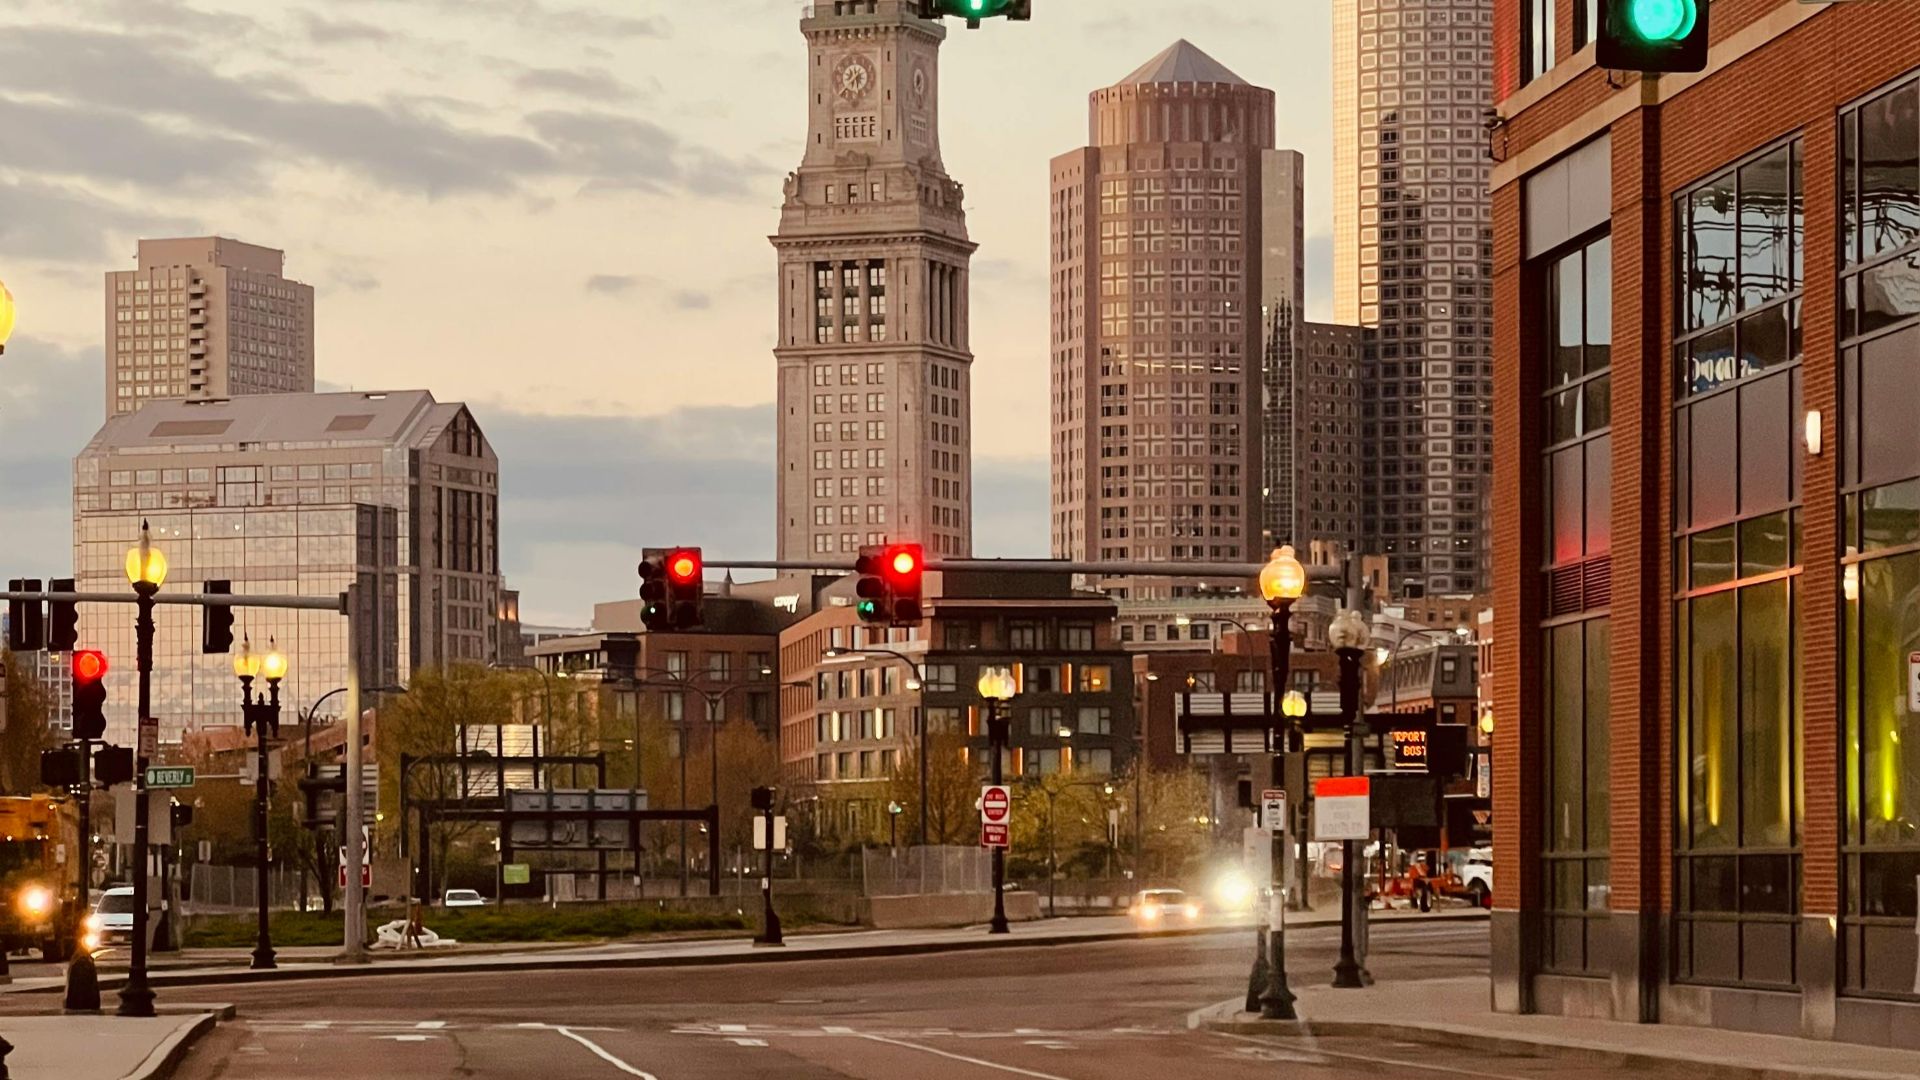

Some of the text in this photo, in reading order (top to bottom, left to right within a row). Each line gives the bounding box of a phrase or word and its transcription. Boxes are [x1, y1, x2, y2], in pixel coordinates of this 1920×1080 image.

[156, 770, 184, 784] BEVERLY
[985, 825, 1006, 834] WRONG
[989, 834, 1001, 842] WAY
